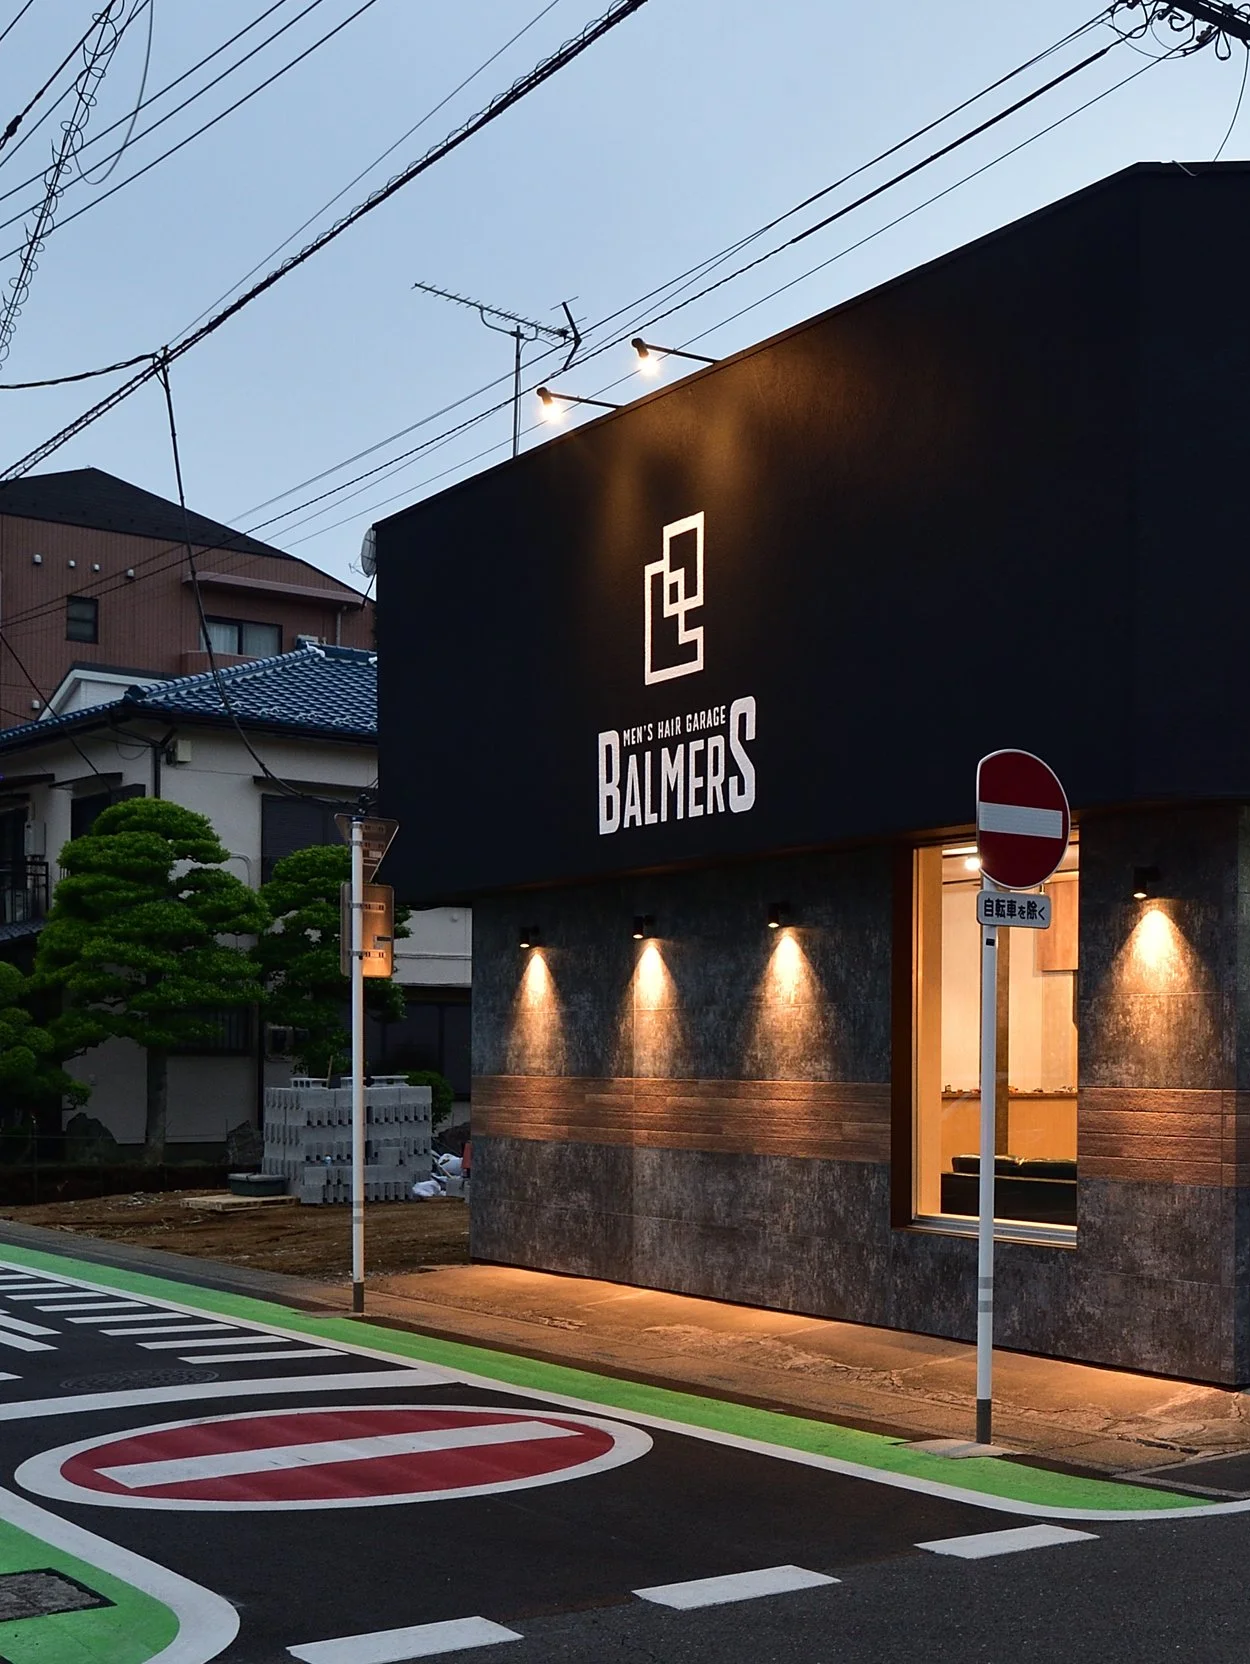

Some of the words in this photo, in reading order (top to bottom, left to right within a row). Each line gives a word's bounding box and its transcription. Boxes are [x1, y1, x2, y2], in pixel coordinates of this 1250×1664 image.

[623, 723, 653, 747] MEN'S
[657, 716, 681, 739] HAIR
[686, 705, 726, 733] GARAGE
[598, 696, 756, 835] BALMERS
[983, 898, 1046, 921] 自転車を除く
